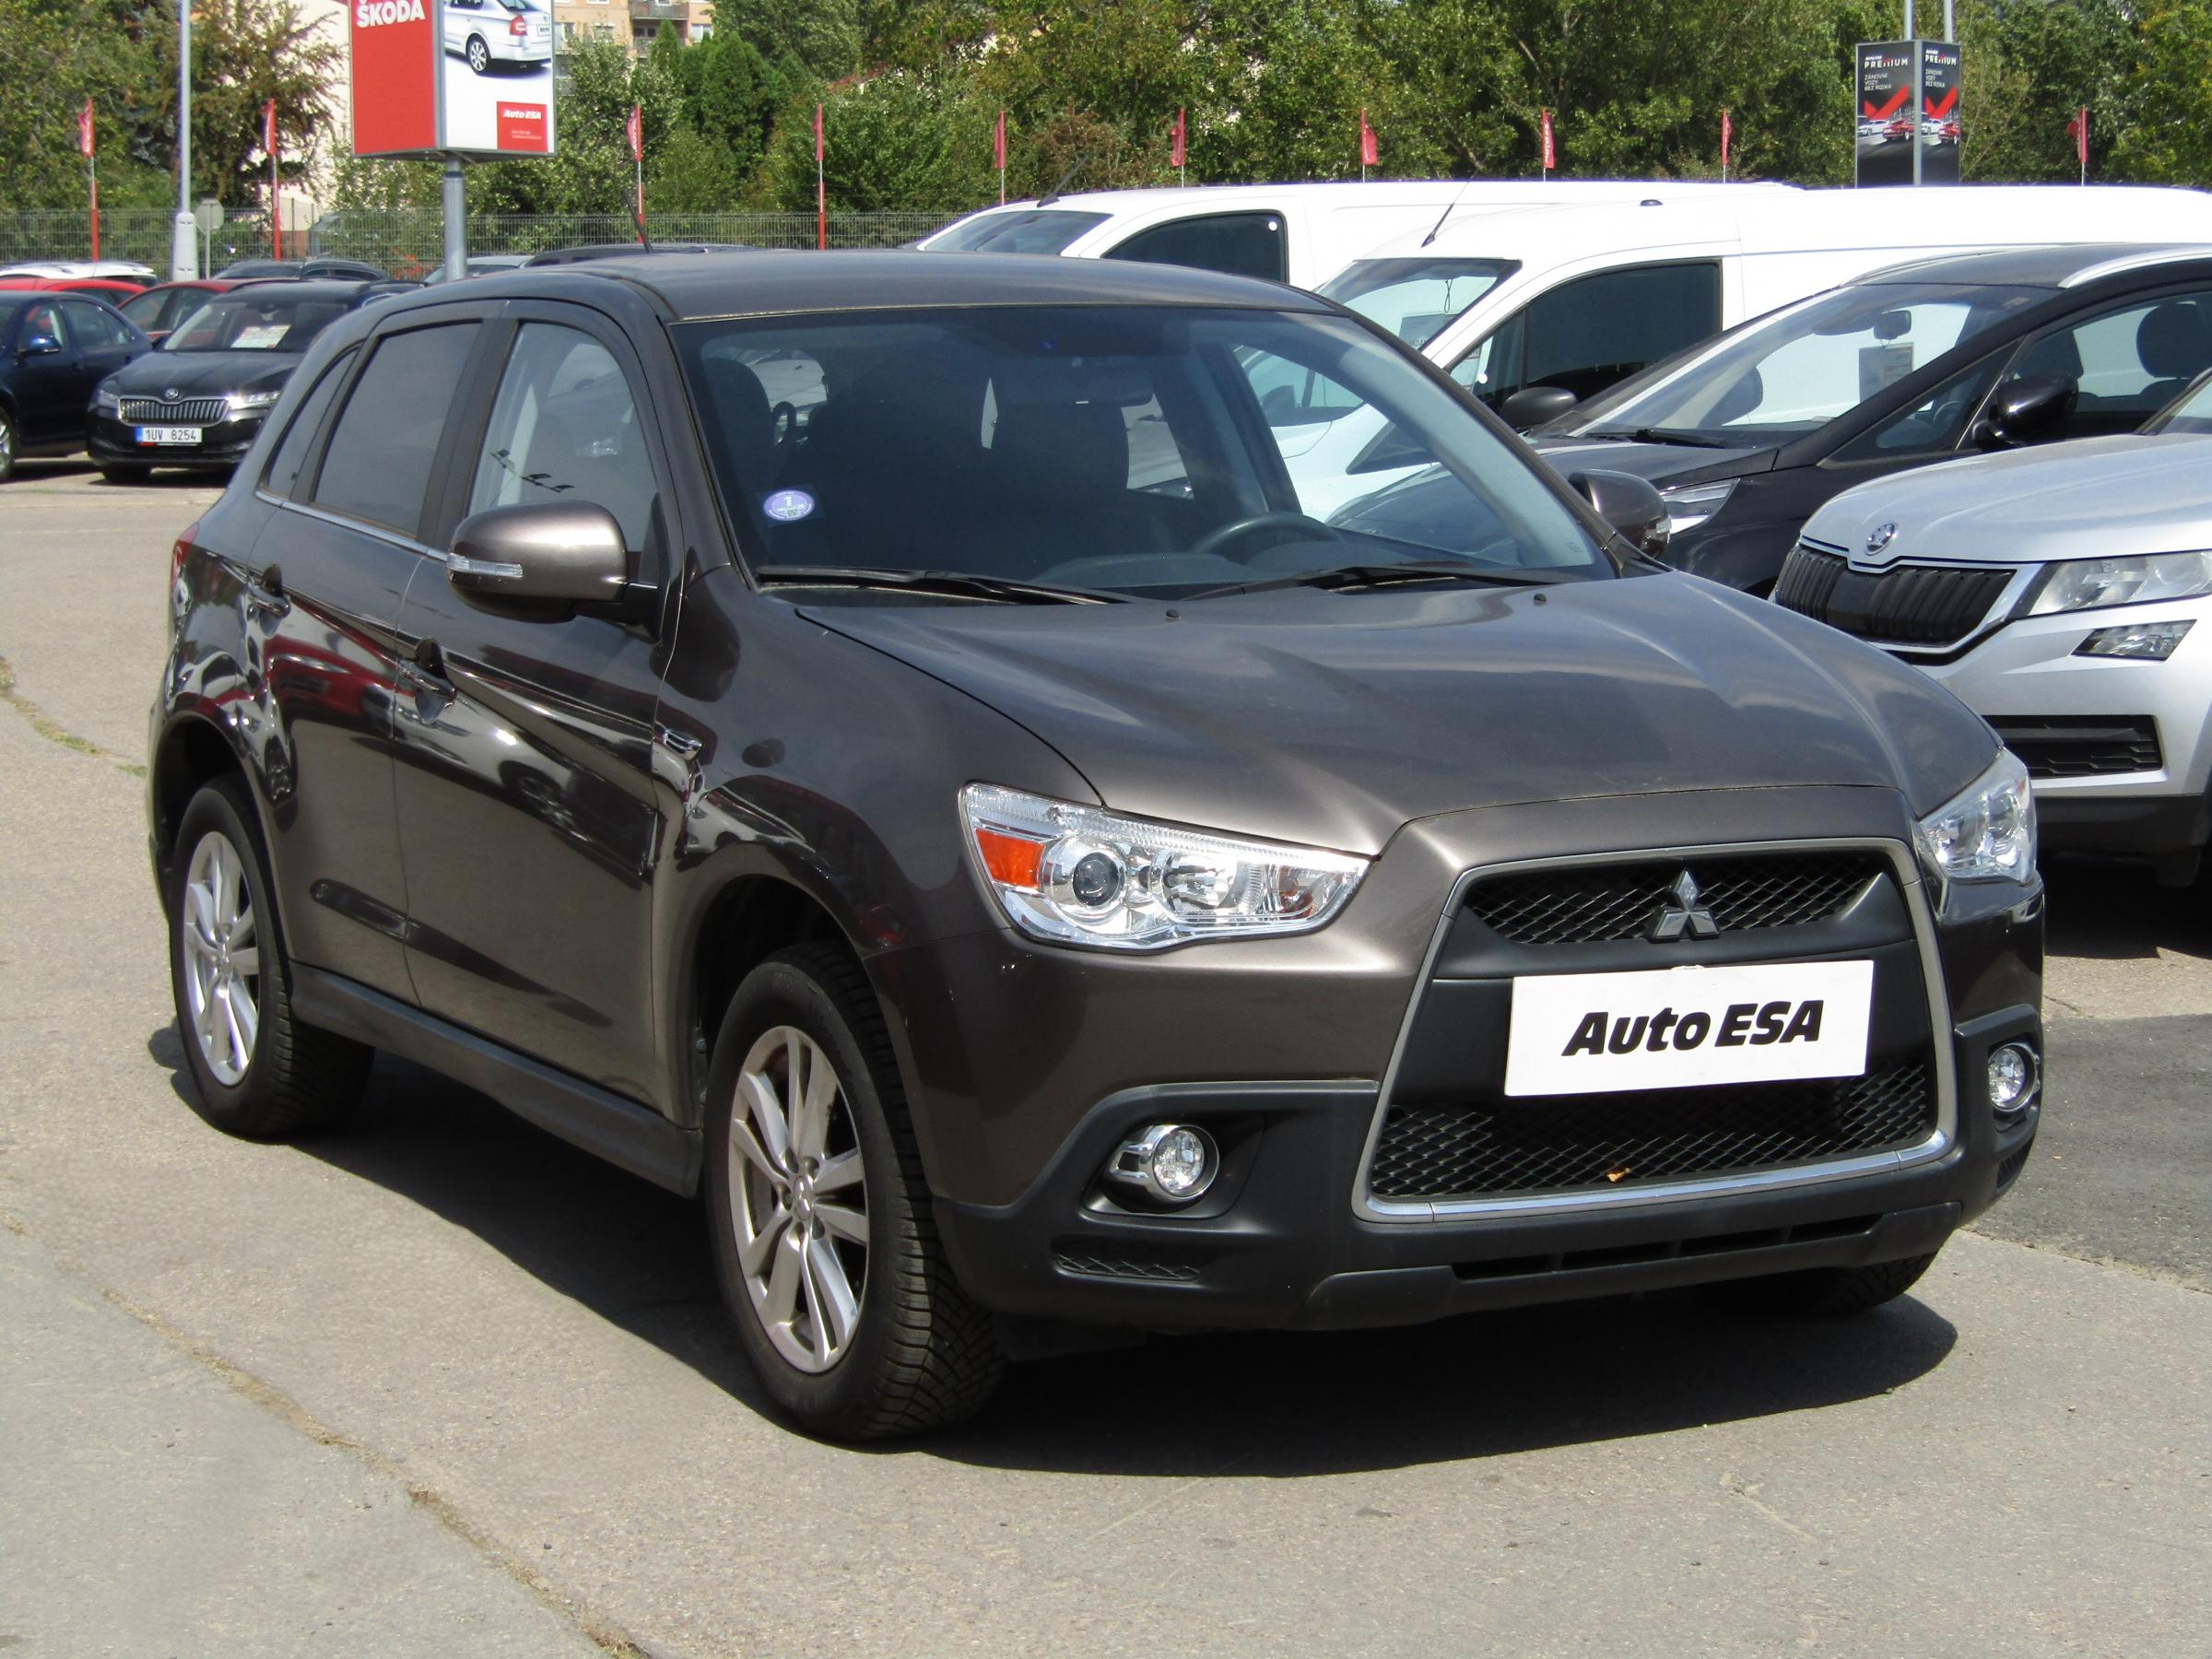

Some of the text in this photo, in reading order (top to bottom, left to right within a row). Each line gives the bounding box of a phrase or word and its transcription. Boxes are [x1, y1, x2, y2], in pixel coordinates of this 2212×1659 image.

[357, 0, 426, 29] ŠKODA
[1864, 58, 1909, 69] PREMIUM
[502, 109, 542, 120] Auto ESA
[146, 429, 196, 441] 1UV 8254
[1560, 999, 1825, 1057] Auto ESA
